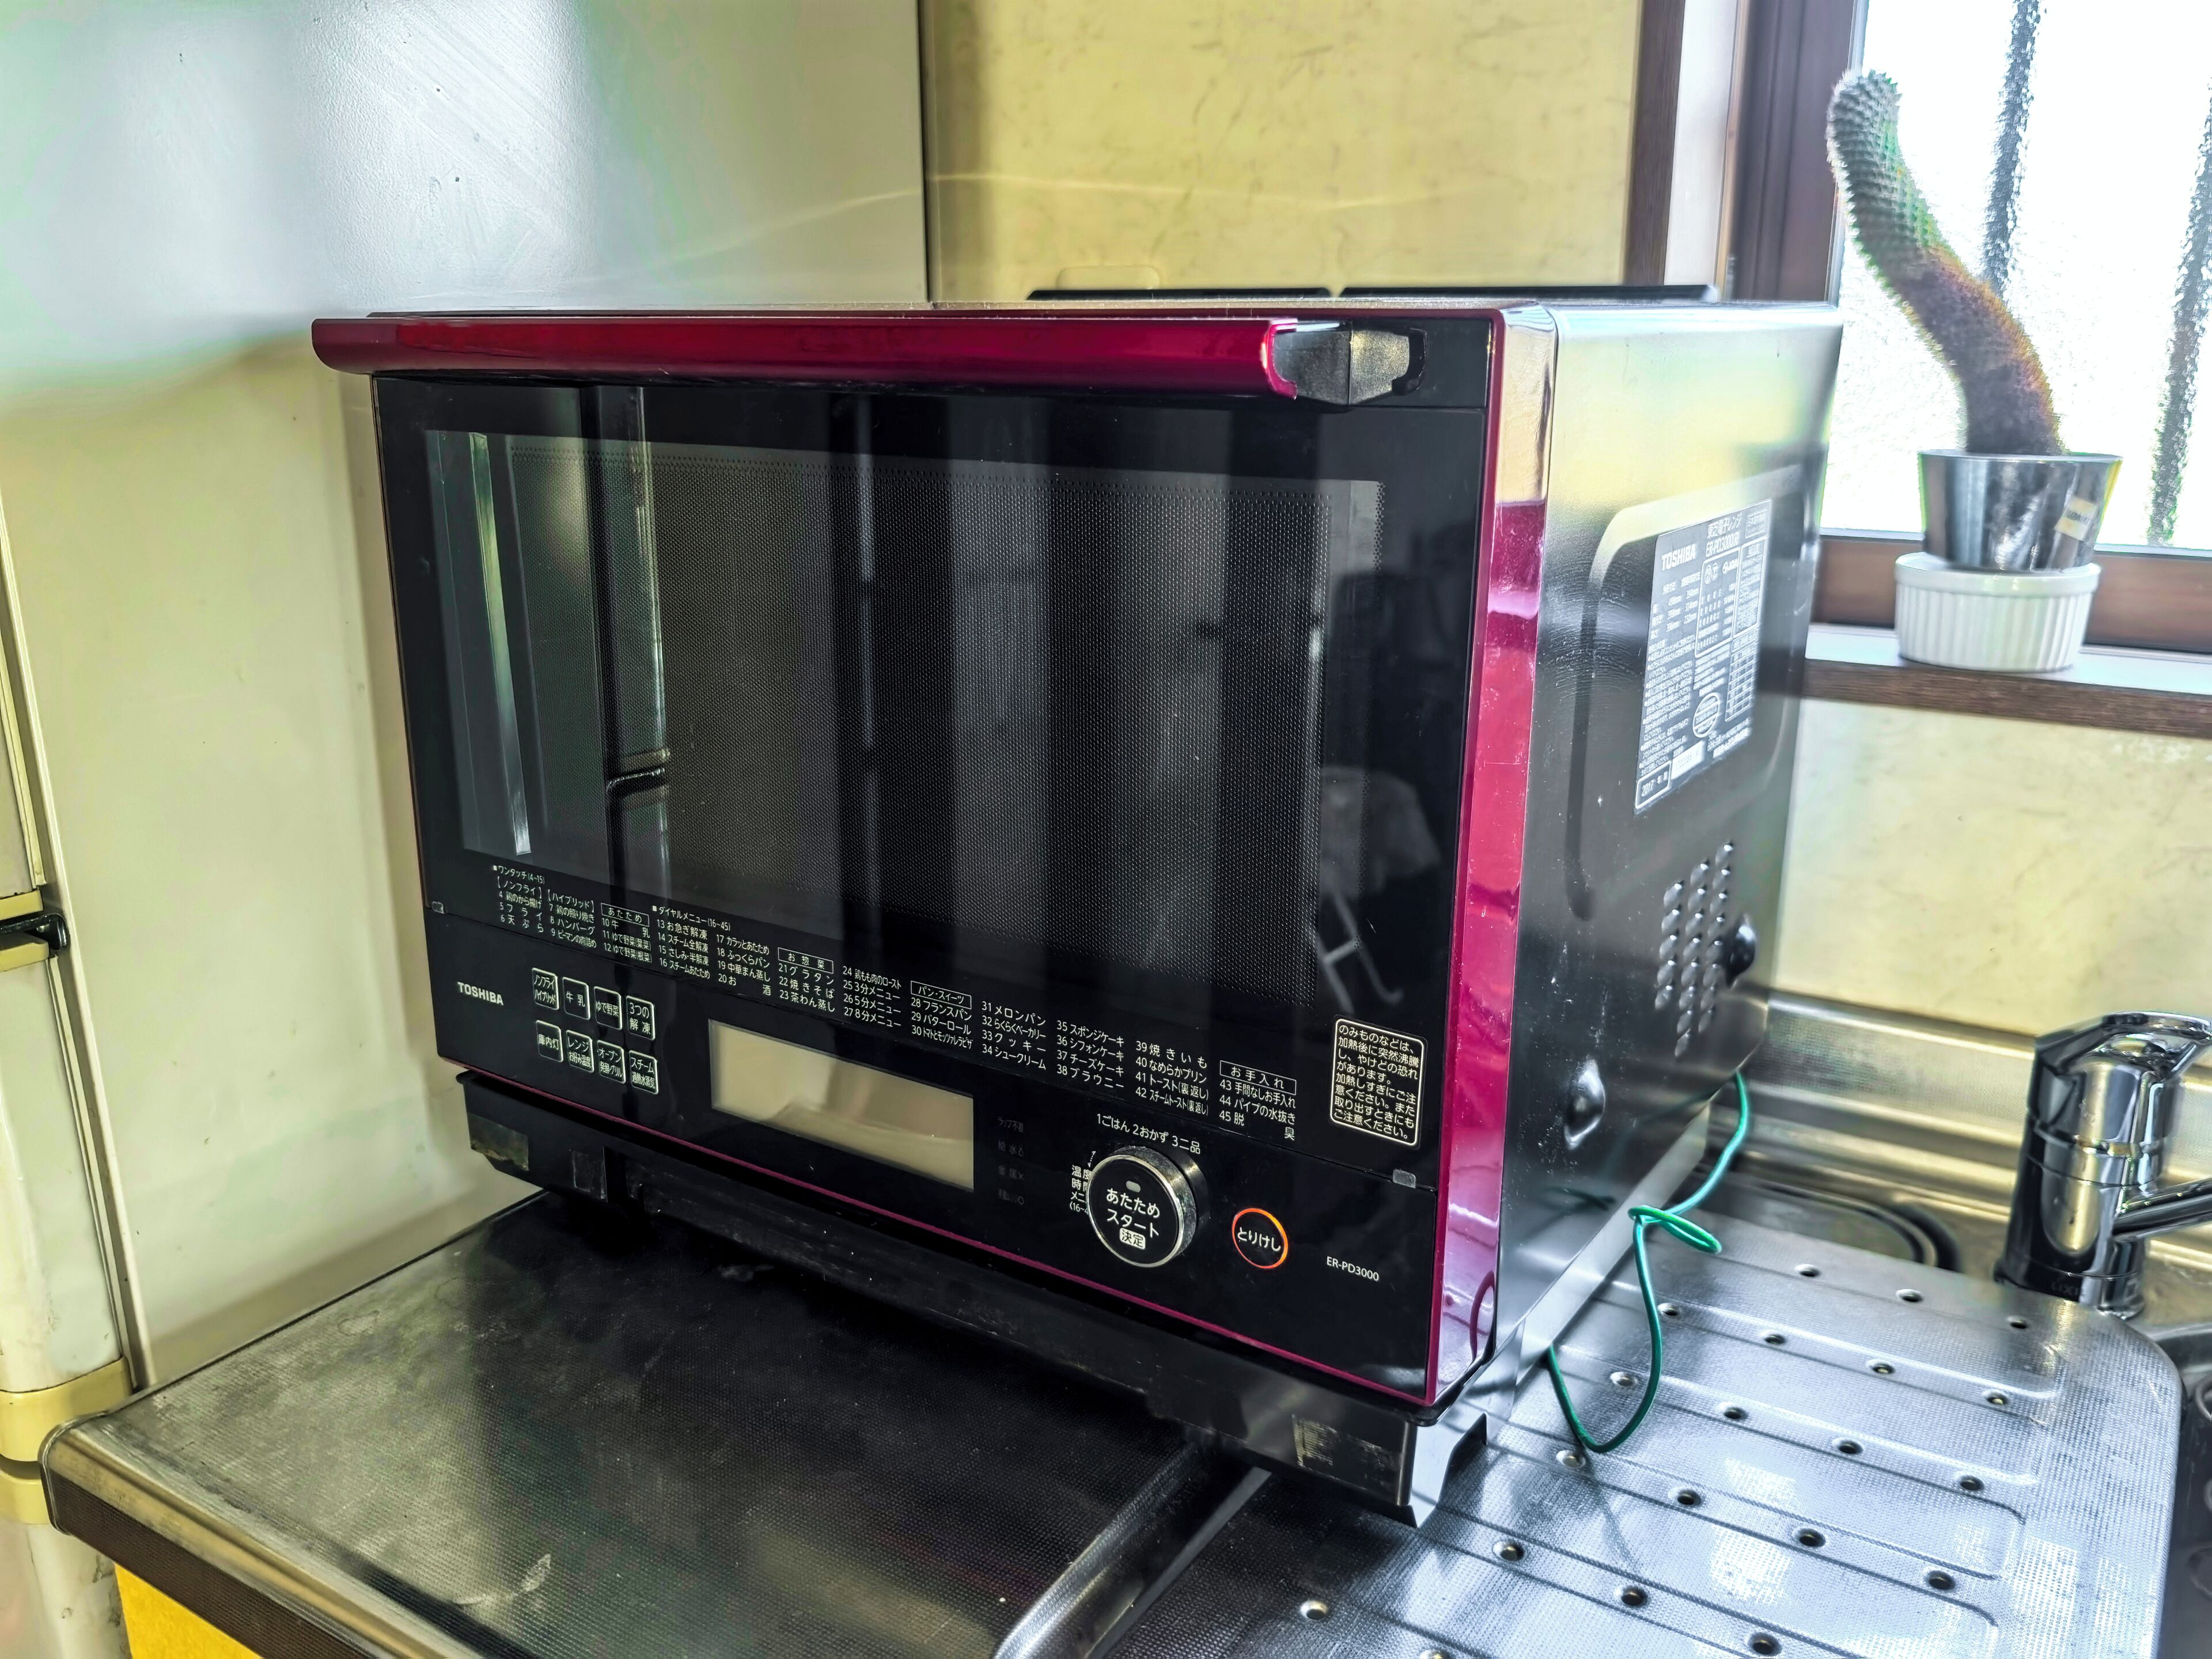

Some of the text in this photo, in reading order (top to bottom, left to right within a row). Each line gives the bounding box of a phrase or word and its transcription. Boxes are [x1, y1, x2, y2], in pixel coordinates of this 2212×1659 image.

[1661, 543, 1696, 571] TOSHIBA
[499, 902, 504, 911] 5
[548, 903, 554, 912] 7
[608, 907, 642, 923] あたため
[500, 914, 505, 923] 6
[550, 915, 596, 935] 8 ハンバーグ
[602, 918, 610, 927] 10
[657, 919, 708, 940] 13 お急ぎ解凍
[551, 928, 555, 937] 9
[602, 930, 610, 940] 11
[658, 932, 709, 953] 14 スチーム全解凍
[604, 942, 612, 952] 12
[716, 934, 770, 955] 17 カラッとあたため
[659, 945, 710, 967] 15 さしみ・半解凍
[717, 948, 770, 968] 18 ふっくらパン
[660, 957, 710, 979] 16 スチームあたため
[718, 960, 771, 982] 19 中華まん蒸し
[718, 974, 727, 983] 20
[778, 963, 787, 974] 21
[842, 965, 902, 990] 24 鶏もも肉のロースト
[533, 975, 555, 991] ノンフライ
[779, 976, 789, 987] 22
[457, 982, 504, 1006] TOSHIBA
[534, 988, 556, 1005] ハイブリッド
[779, 990, 835, 1013] 23 茶わん蒸し
[595, 1001, 619, 1017] ゆで野菜
[629, 1002, 650, 1019] 3つの
[911, 997, 972, 1021] 28 フランスパン
[982, 1001, 1046, 1027] 31 メロンパン
[911, 1012, 972, 1036] 29 バターロール
[912, 1025, 922, 1036] 30
[982, 1015, 1046, 1040] 32 らくらくベーカリー
[982, 1029, 993, 1040] 33
[1056, 1020, 1124, 1047] 35 スポンジケーキ
[538, 1034, 559, 1051] 庫内灯
[568, 1036, 589, 1052] レンジ
[1056, 1035, 1124, 1062] 36 シフォンケーキ
[1135, 1040, 1147, 1052] 39
[1339, 1024, 1414, 1054] のみものなどは、
[982, 1044, 1047, 1071] 34 シュークリーム
[1056, 1050, 1124, 1077] 37 チーズケーキ
[1338, 1036, 1419, 1069] 加熱後に突然沸騰
[631, 1056, 654, 1075] スチーム
[1056, 1064, 1124, 1088] 38 ブラウニー
[1135, 1056, 1207, 1084] 40 なめらかプリン
[1336, 1060, 1391, 1085] があります。
[1135, 1072, 1209, 1101] 41 トースト(裏返し)
[1230, 1066, 1285, 1089] お手入れ
[1335, 1072, 1416, 1105] 加熱しすぎにご注
[1135, 1086, 1147, 1099] 42
[1220, 1079, 1296, 1109] 43 手間なしお手入れ
[1335, 1084, 1415, 1116] 意ください。また
[1219, 1094, 1296, 1126] 44 パイプの水抜き
[1219, 1110, 1231, 1122] 45
[1334, 1095, 1414, 1129] 取り出すときにも
[1096, 1113, 1130, 1133] 1ごはん
[1132, 1124, 1169, 1144] 2おかず
[1334, 1108, 1408, 1139] ご注意ください。
[1071, 1164, 1093, 1180] 温度
[1070, 1191, 1086, 1203] メニ
[1106, 1187, 1161, 1219] あたため
[1106, 1208, 1160, 1238] スタート
[1121, 1229, 1144, 1248] 決定
[1236, 1230, 1282, 1253] とりけし
[1327, 1255, 1380, 1281] ER-PD3000
